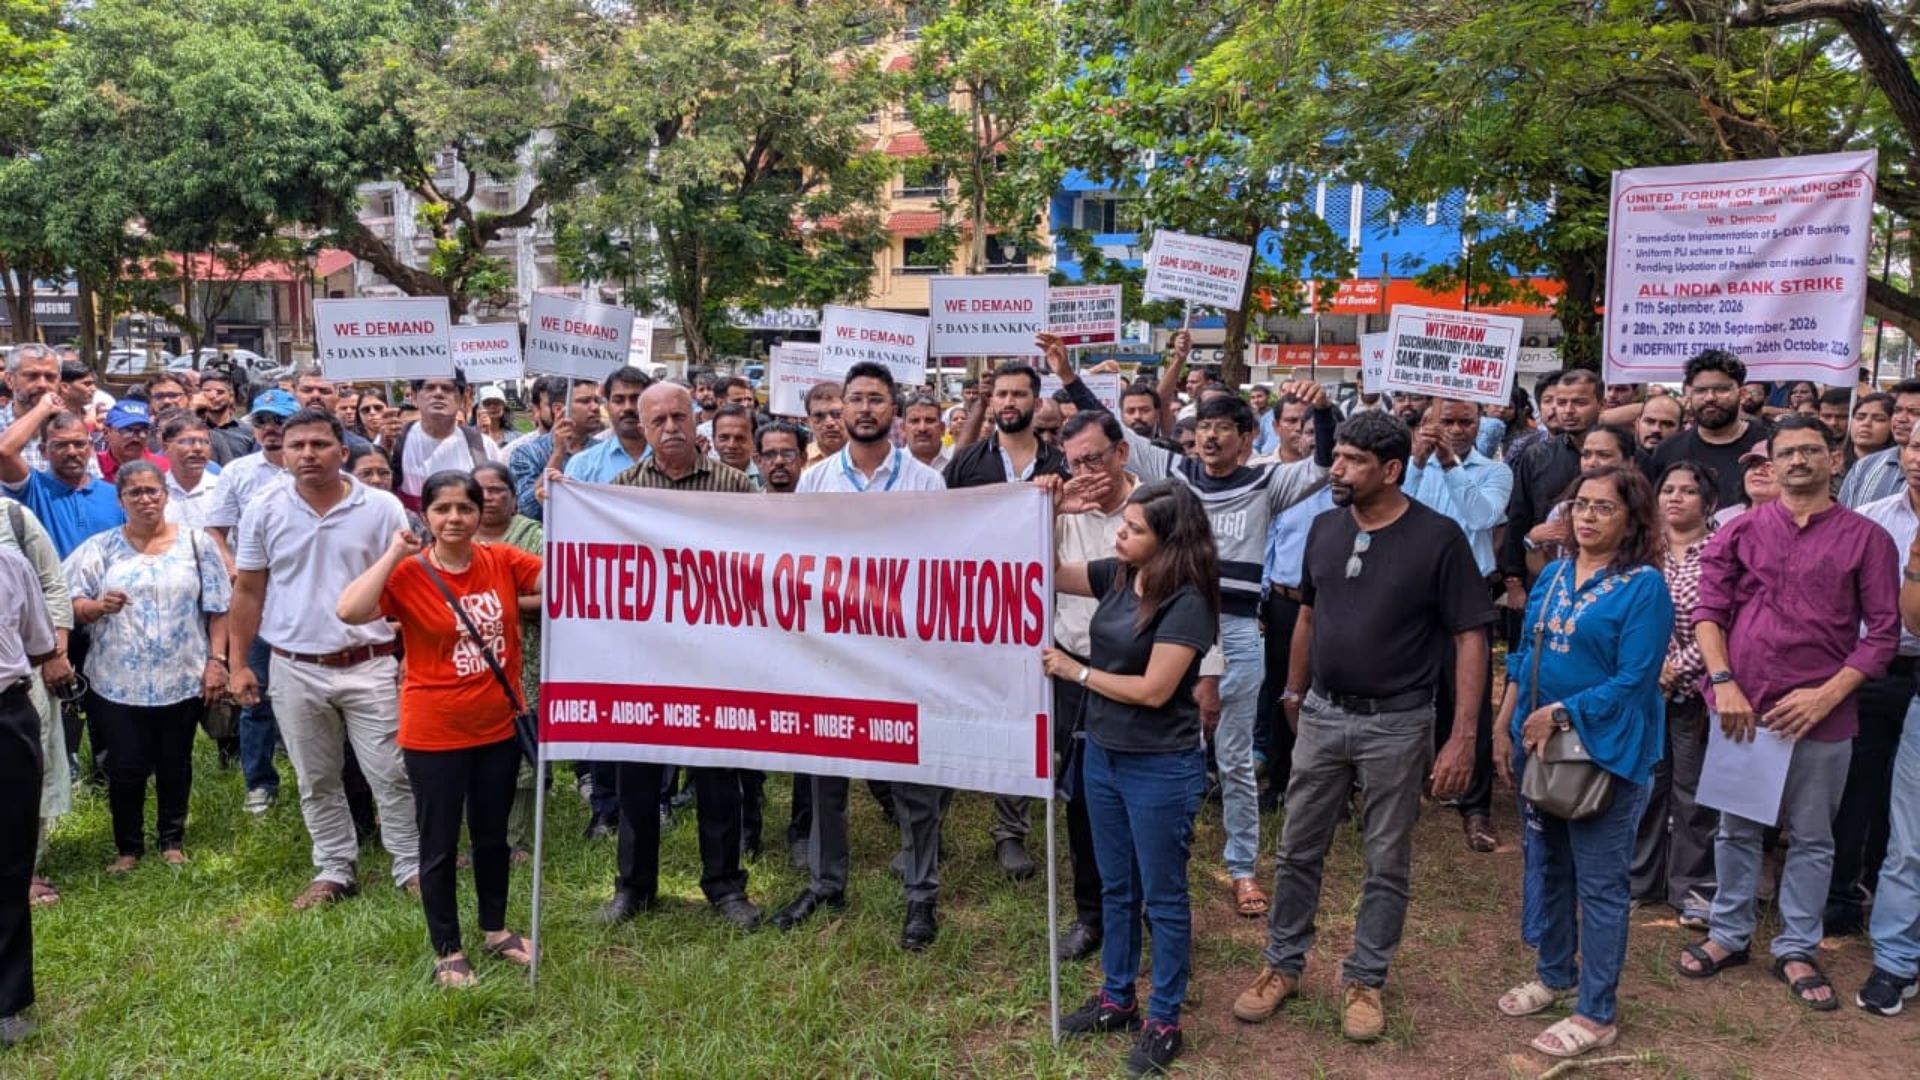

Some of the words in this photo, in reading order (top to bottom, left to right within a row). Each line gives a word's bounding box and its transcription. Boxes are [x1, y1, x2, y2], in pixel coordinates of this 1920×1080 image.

[1626, 192, 1674, 204] UNITED
[1681, 189, 1731, 201] FORUM
[1735, 188, 1754, 199] OF
[1758, 184, 1797, 198] BANK
[1801, 178, 1863, 194] UNIONS
[1706, 215, 1724, 225] We
[1730, 213, 1777, 224] Demand
[1636, 233, 1686, 243] Immediate
[1688, 230, 1759, 242] Implementation
[1760, 229, 1771, 239] of
[1772, 226, 1805, 239] 5-DAY
[1636, 248, 1672, 259] Uniform
[1674, 246, 1687, 257] PLI
[1690, 246, 1723, 257] scheme
[1725, 246, 1735, 255] to
[1159, 254, 1179, 269] SAME
[1180, 258, 1201, 272] WORK
[1208, 263, 1227, 278] SAME
[1636, 263, 1673, 274] Pending
[1675, 262, 1717, 273] Updation
[1718, 261, 1727, 271] of
[1729, 260, 1768, 271] Pension
[1769, 259, 1787, 269] and
[1790, 254, 1832, 268] residual
[1638, 284, 1668, 297] ALL
[1674, 283, 1721, 297] INDIA
[1727, 281, 1774, 295] BANK
[1781, 277, 1844, 293] STRIKE
[945, 299, 967, 312] WE
[972, 299, 1032, 312] DEMAND
[1635, 302, 1655, 314] 11th
[1657, 301, 1716, 317] September,
[1719, 300, 1744, 313] 2026
[333, 322, 360, 337] WE
[365, 321, 434, 335] DEMAND
[541, 315, 560, 331] WE
[564, 319, 619, 340] DEMAND
[781, 311, 816, 327] PLAZA
[936, 323, 943, 334] 5
[945, 323, 979, 334] DAYS
[982, 322, 1040, 334] BANKING
[1662, 322, 1685, 335] 29th
[1688, 323, 1695, 335] &
[1698, 321, 1721, 335] 30th
[1724, 321, 1786, 338] September,
[1789, 318, 1817, 331] 2026
[836, 325, 856, 338] WE
[860, 329, 915, 346] DEMAND
[1425, 321, 1486, 342] WITHDRAW
[326, 349, 334, 359] 5
[338, 346, 376, 359] DAYS
[380, 345, 446, 358] BANKING
[461, 339, 509, 352] DEMAND
[531, 338, 537, 349] 5
[540, 340, 568, 354] DAYS
[571, 343, 623, 362] BANKING
[826, 345, 832, 354] 5
[835, 345, 865, 358] DAYS
[868, 349, 921, 365] BANKING
[1462, 342, 1474, 356] PLI
[1475, 344, 1506, 360] SCHEME
[1633, 343, 1688, 356] INDEFINITE
[1728, 344, 1752, 357] from
[1756, 341, 1781, 354] 26th
[471, 355, 517, 366] BANKING
[1395, 350, 1422, 368] SAME
[1422, 353, 1451, 373] WORK
[1459, 358, 1485, 376] SAME
[1487, 360, 1503, 380] PLI
[1213, 510, 1247, 541] IEGO
[546, 541, 657, 622] UNITED
[663, 548, 769, 628] FORUM
[773, 553, 816, 633] OF
[822, 555, 910, 639] BANK
[916, 559, 1044, 648] UNIONS
[550, 699, 597, 725] (AIBEA
[663, 703, 701, 728] NCBE
[714, 706, 757, 732] AIBOA
[770, 709, 801, 735] BEFI
[813, 713, 855, 739] INBEF
[869, 718, 914, 745] INBOC
